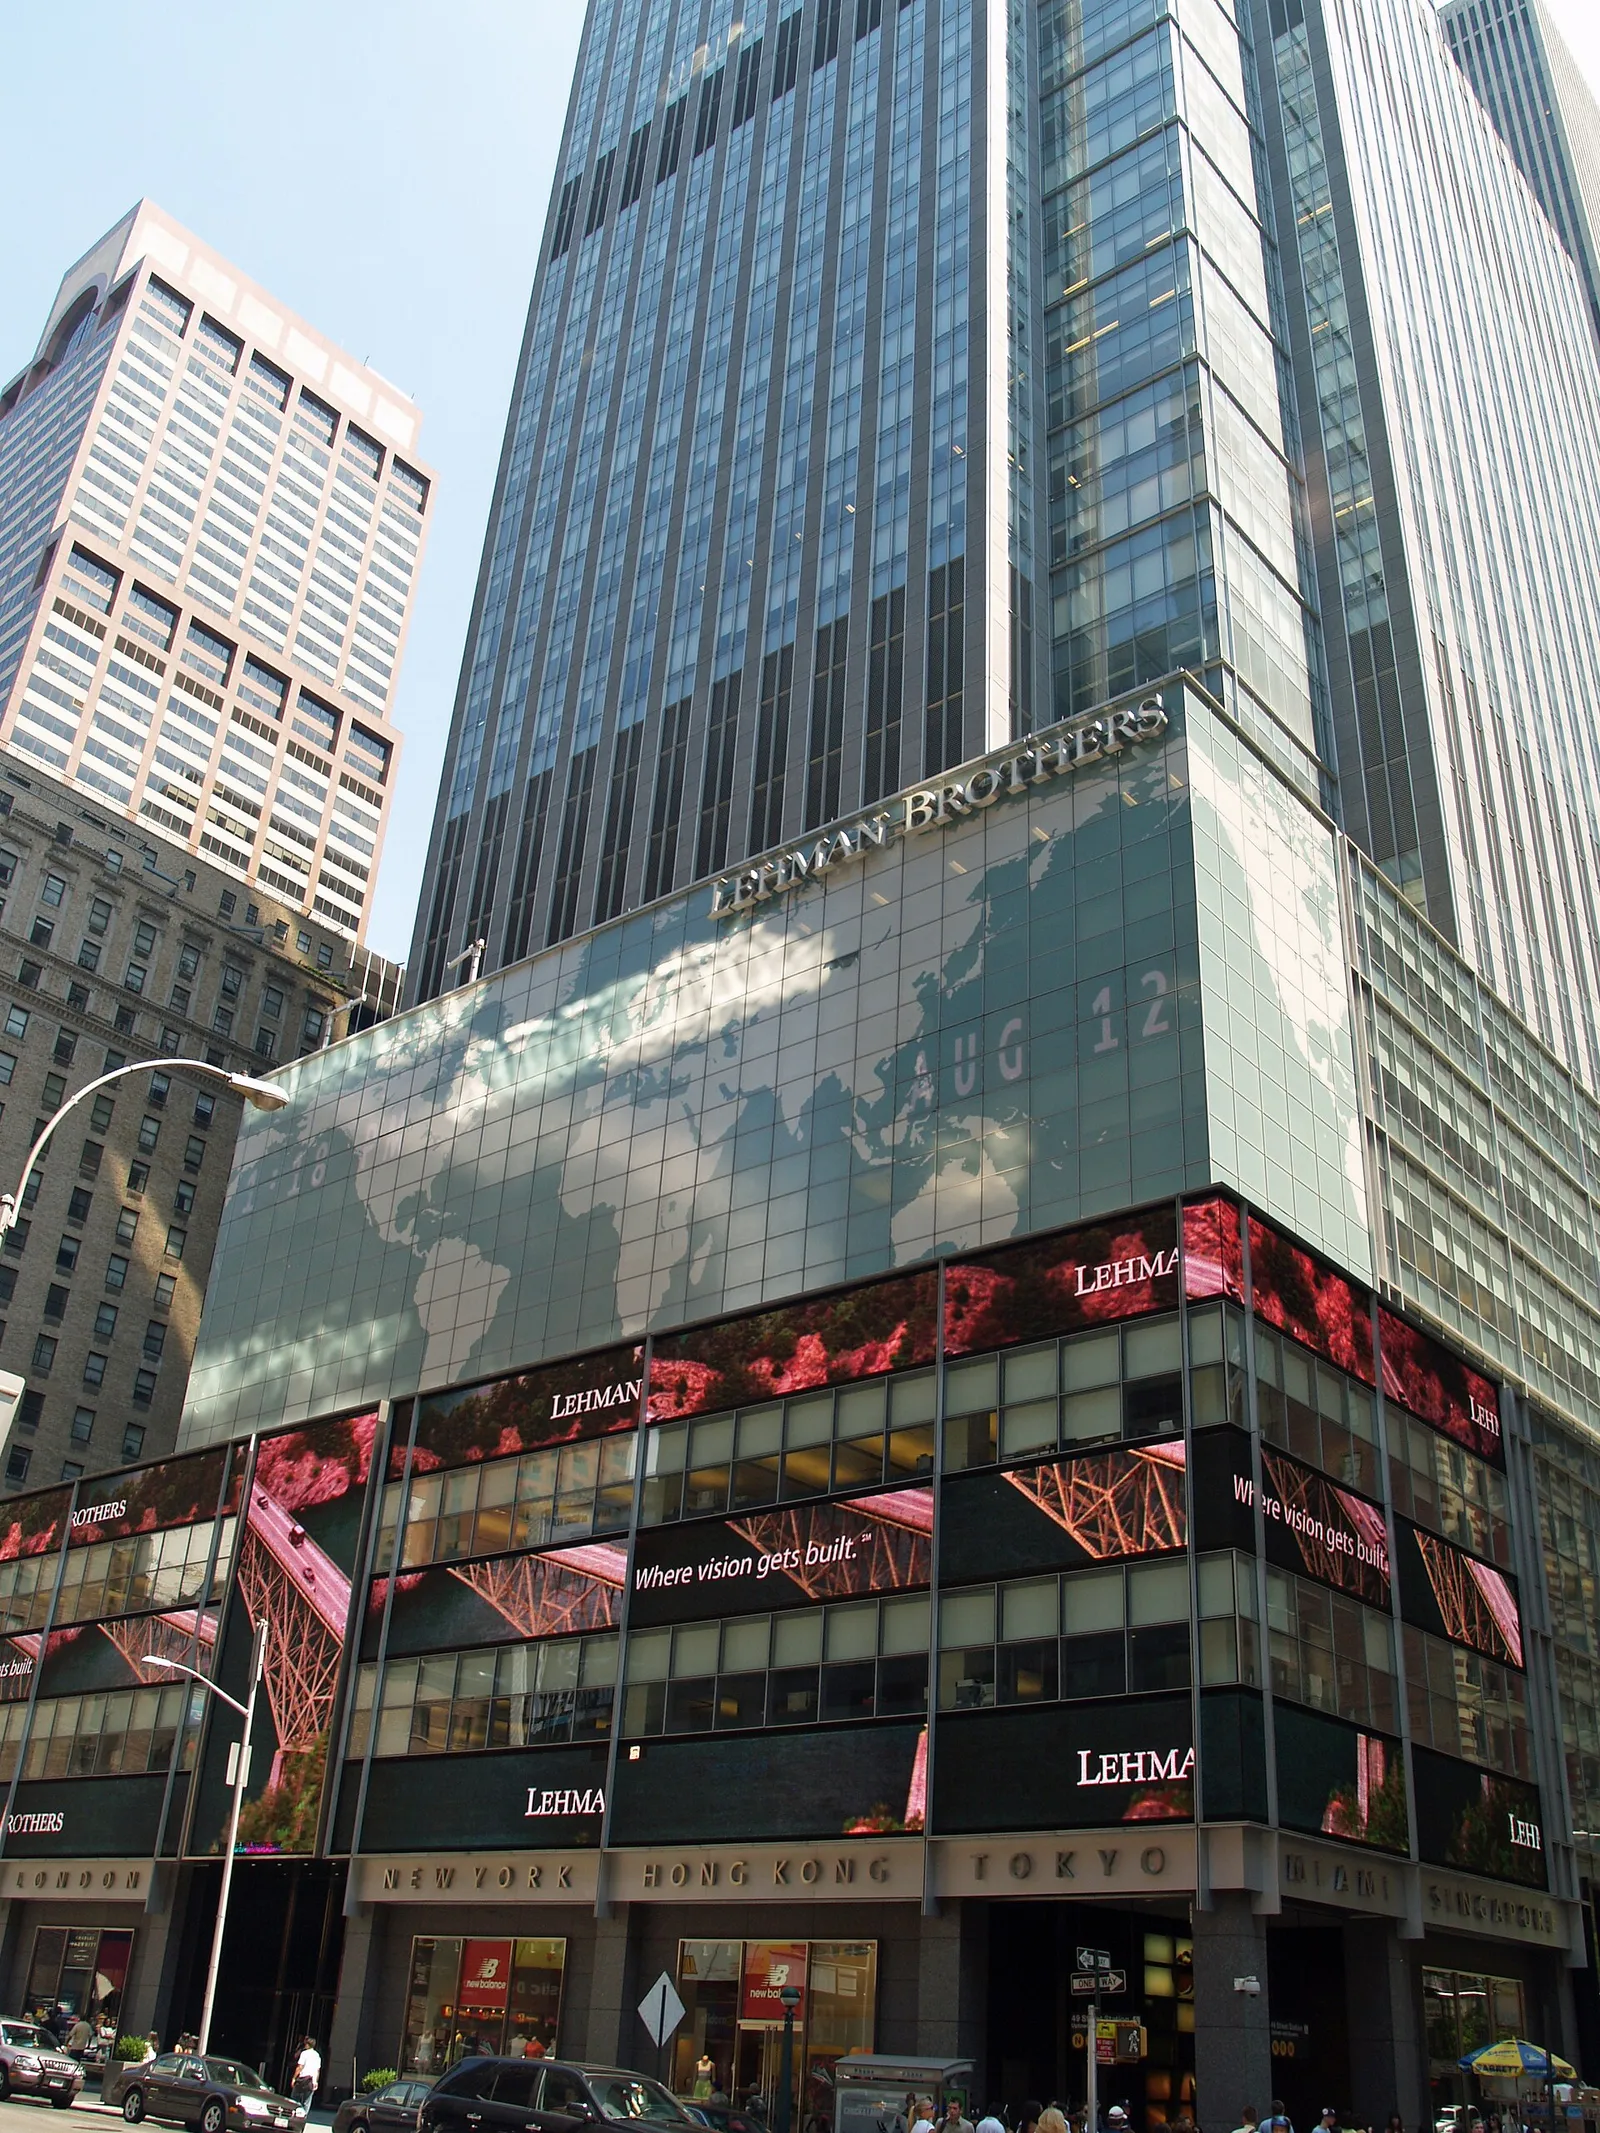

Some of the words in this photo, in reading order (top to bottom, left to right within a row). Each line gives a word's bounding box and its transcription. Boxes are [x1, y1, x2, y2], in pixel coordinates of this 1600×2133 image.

[707, 812, 891, 921] LEHMAN
[901, 692, 1169, 837] BROTHERS
[904, 1017, 1023, 1107] AUG
[1092, 969, 1170, 1054] 12
[550, 1379, 643, 1420] LEHMAN
[1284, 1504, 1323, 1541] vision
[1326, 1526, 1354, 1556] gets
[635, 1564, 693, 1591] Where
[698, 1554, 752, 1582] vision
[756, 1548, 800, 1579] gets
[804, 1534, 858, 1565] built.
[16, 1870, 141, 1890] LONDON
[382, 1867, 455, 1889] NEW
[473, 1865, 574, 1889] YORK
[643, 1860, 749, 1888] HONG
[773, 1858, 890, 1886] KONG
[969, 1847, 1166, 1881] TOKYO
[1285, 1854, 1389, 1900] MIAMI
[1428, 1885, 1560, 1935] SINGAPORE
[479, 1979, 507, 1990] balance
[750, 1988, 767, 1999] new
[1078, 1979, 1093, 1987] ONE
[1101, 1977, 1118, 1986] WAY
